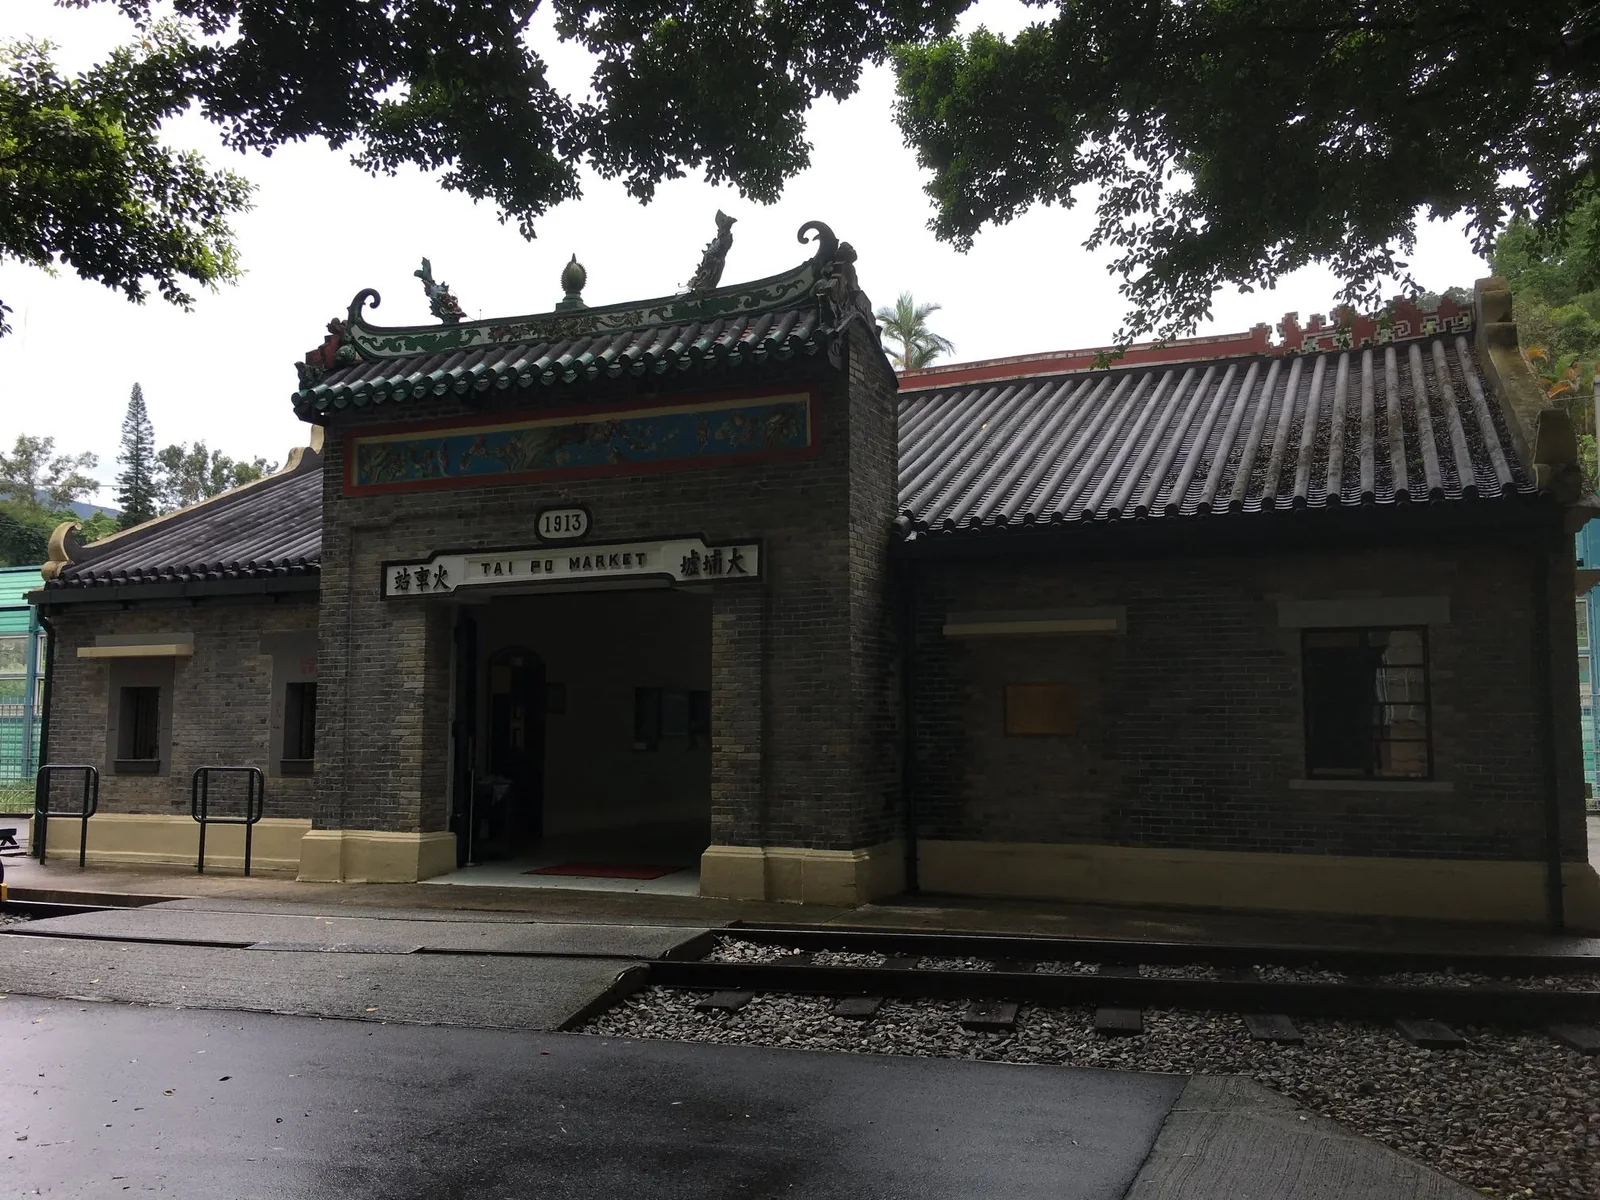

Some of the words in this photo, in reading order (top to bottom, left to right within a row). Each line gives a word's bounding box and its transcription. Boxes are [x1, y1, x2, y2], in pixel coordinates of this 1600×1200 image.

[544, 514, 581, 533] 1913
[481, 561, 513, 575] TAI
[531, 559, 553, 573] PO
[568, 552, 646, 570] MARKET
